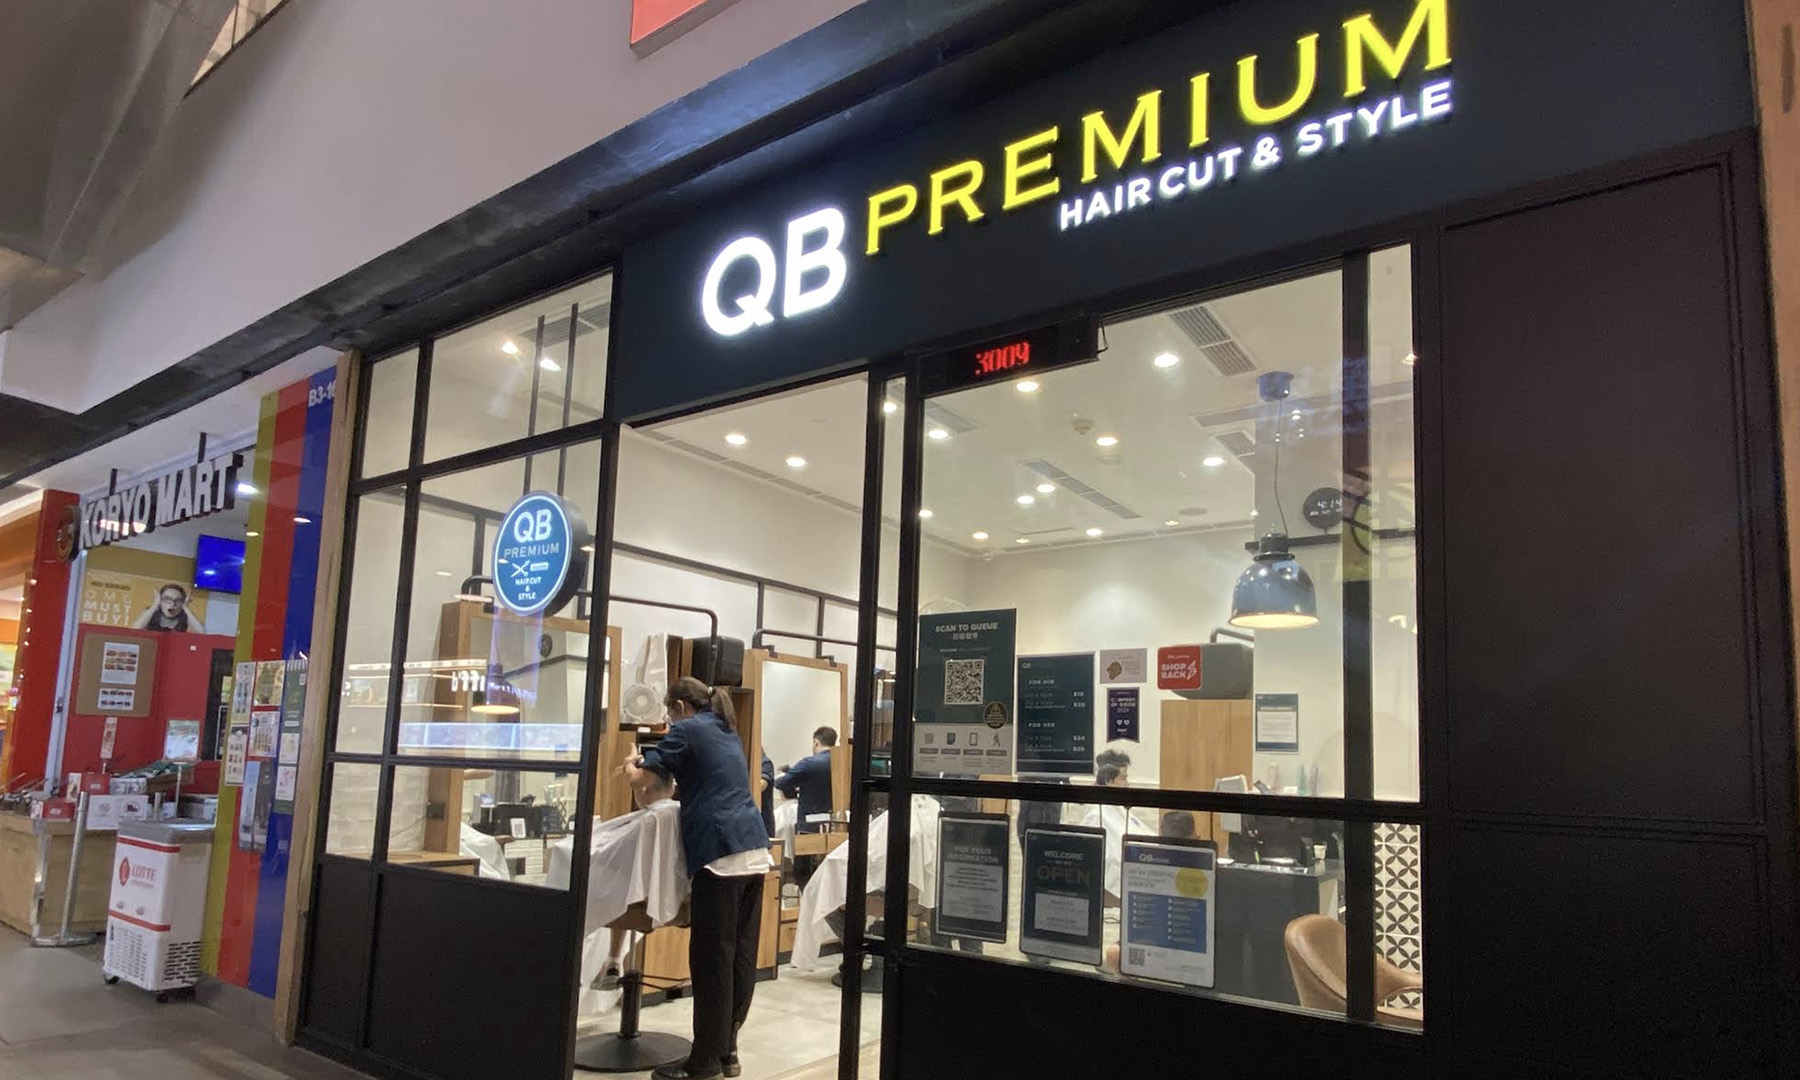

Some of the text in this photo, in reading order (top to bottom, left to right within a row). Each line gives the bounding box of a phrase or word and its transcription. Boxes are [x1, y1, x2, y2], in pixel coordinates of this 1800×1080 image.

[1250, 136, 1281, 169] &
[1297, 80, 1452, 155] STYLE
[702, 0, 1452, 337] QB PREMIUM
[975, 341, 1030, 374] 3009
[79, 452, 234, 550] KORYO MART
[513, 508, 552, 543] QB
[503, 543, 560, 559] PREMIUM
[518, 592, 536, 600] STYLE
[935, 624, 957, 633] SCAN
[970, 622, 999, 630] QUEUE
[1161, 663, 1187, 671] SHOP
[1161, 671, 1187, 679] BACK
[1043, 850, 1084, 860] WELCOME
